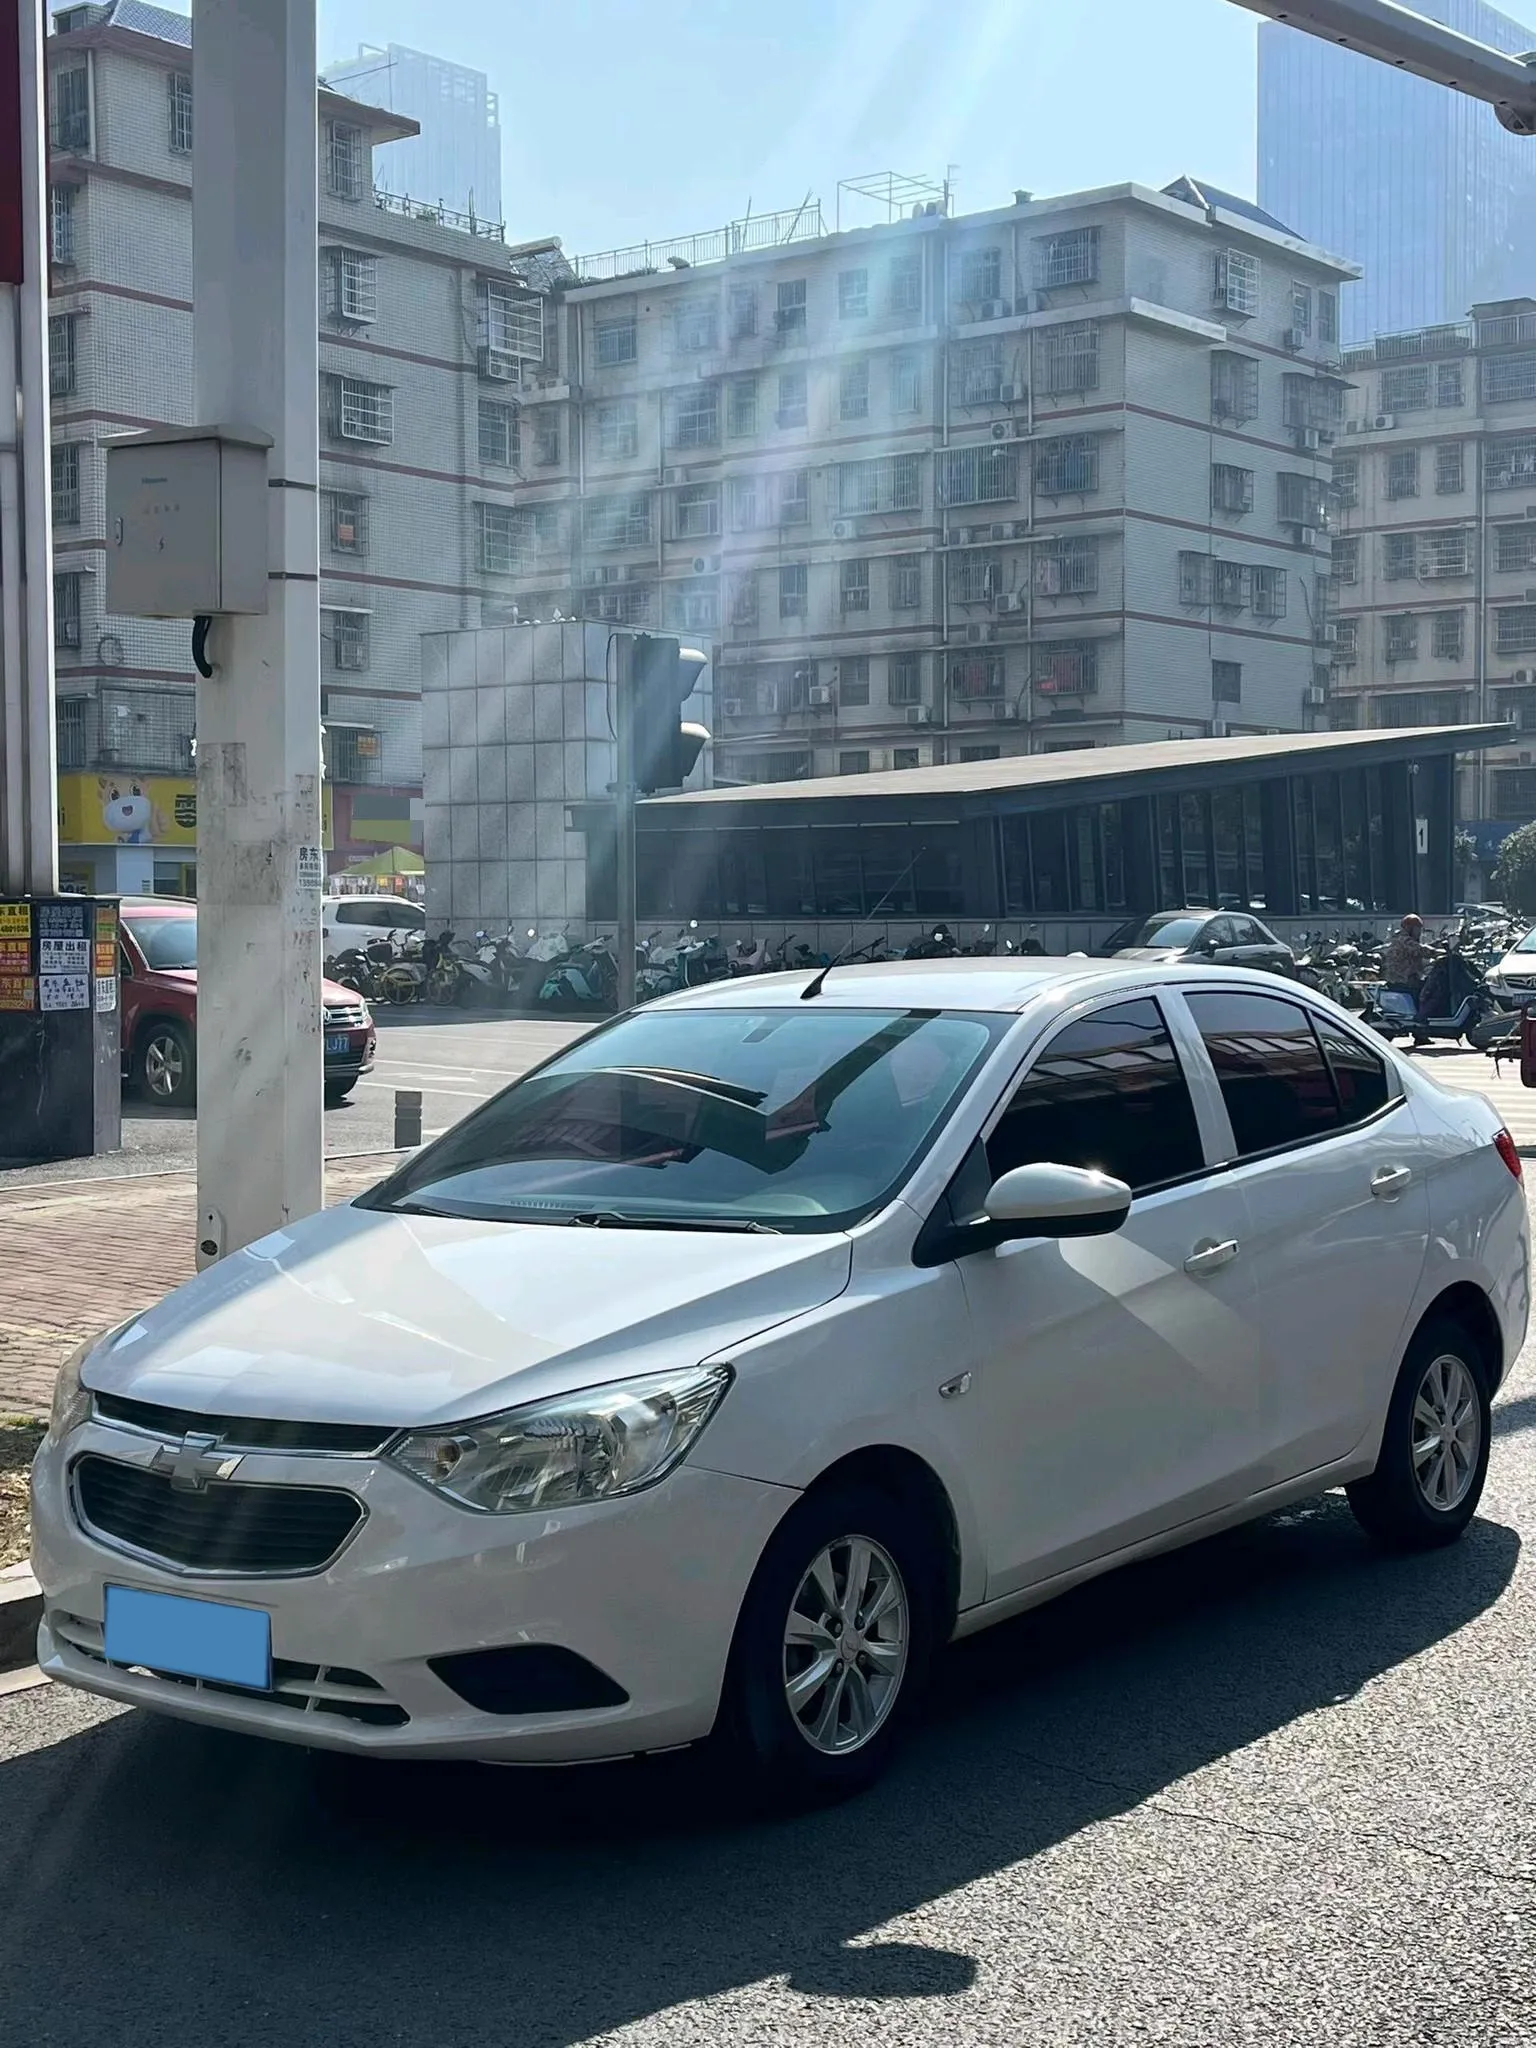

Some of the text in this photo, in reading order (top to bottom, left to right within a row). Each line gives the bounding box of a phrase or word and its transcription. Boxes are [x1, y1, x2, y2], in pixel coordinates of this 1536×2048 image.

[1418, 828, 1424, 847] 1
[42, 941, 87, 951] 房屋出租
